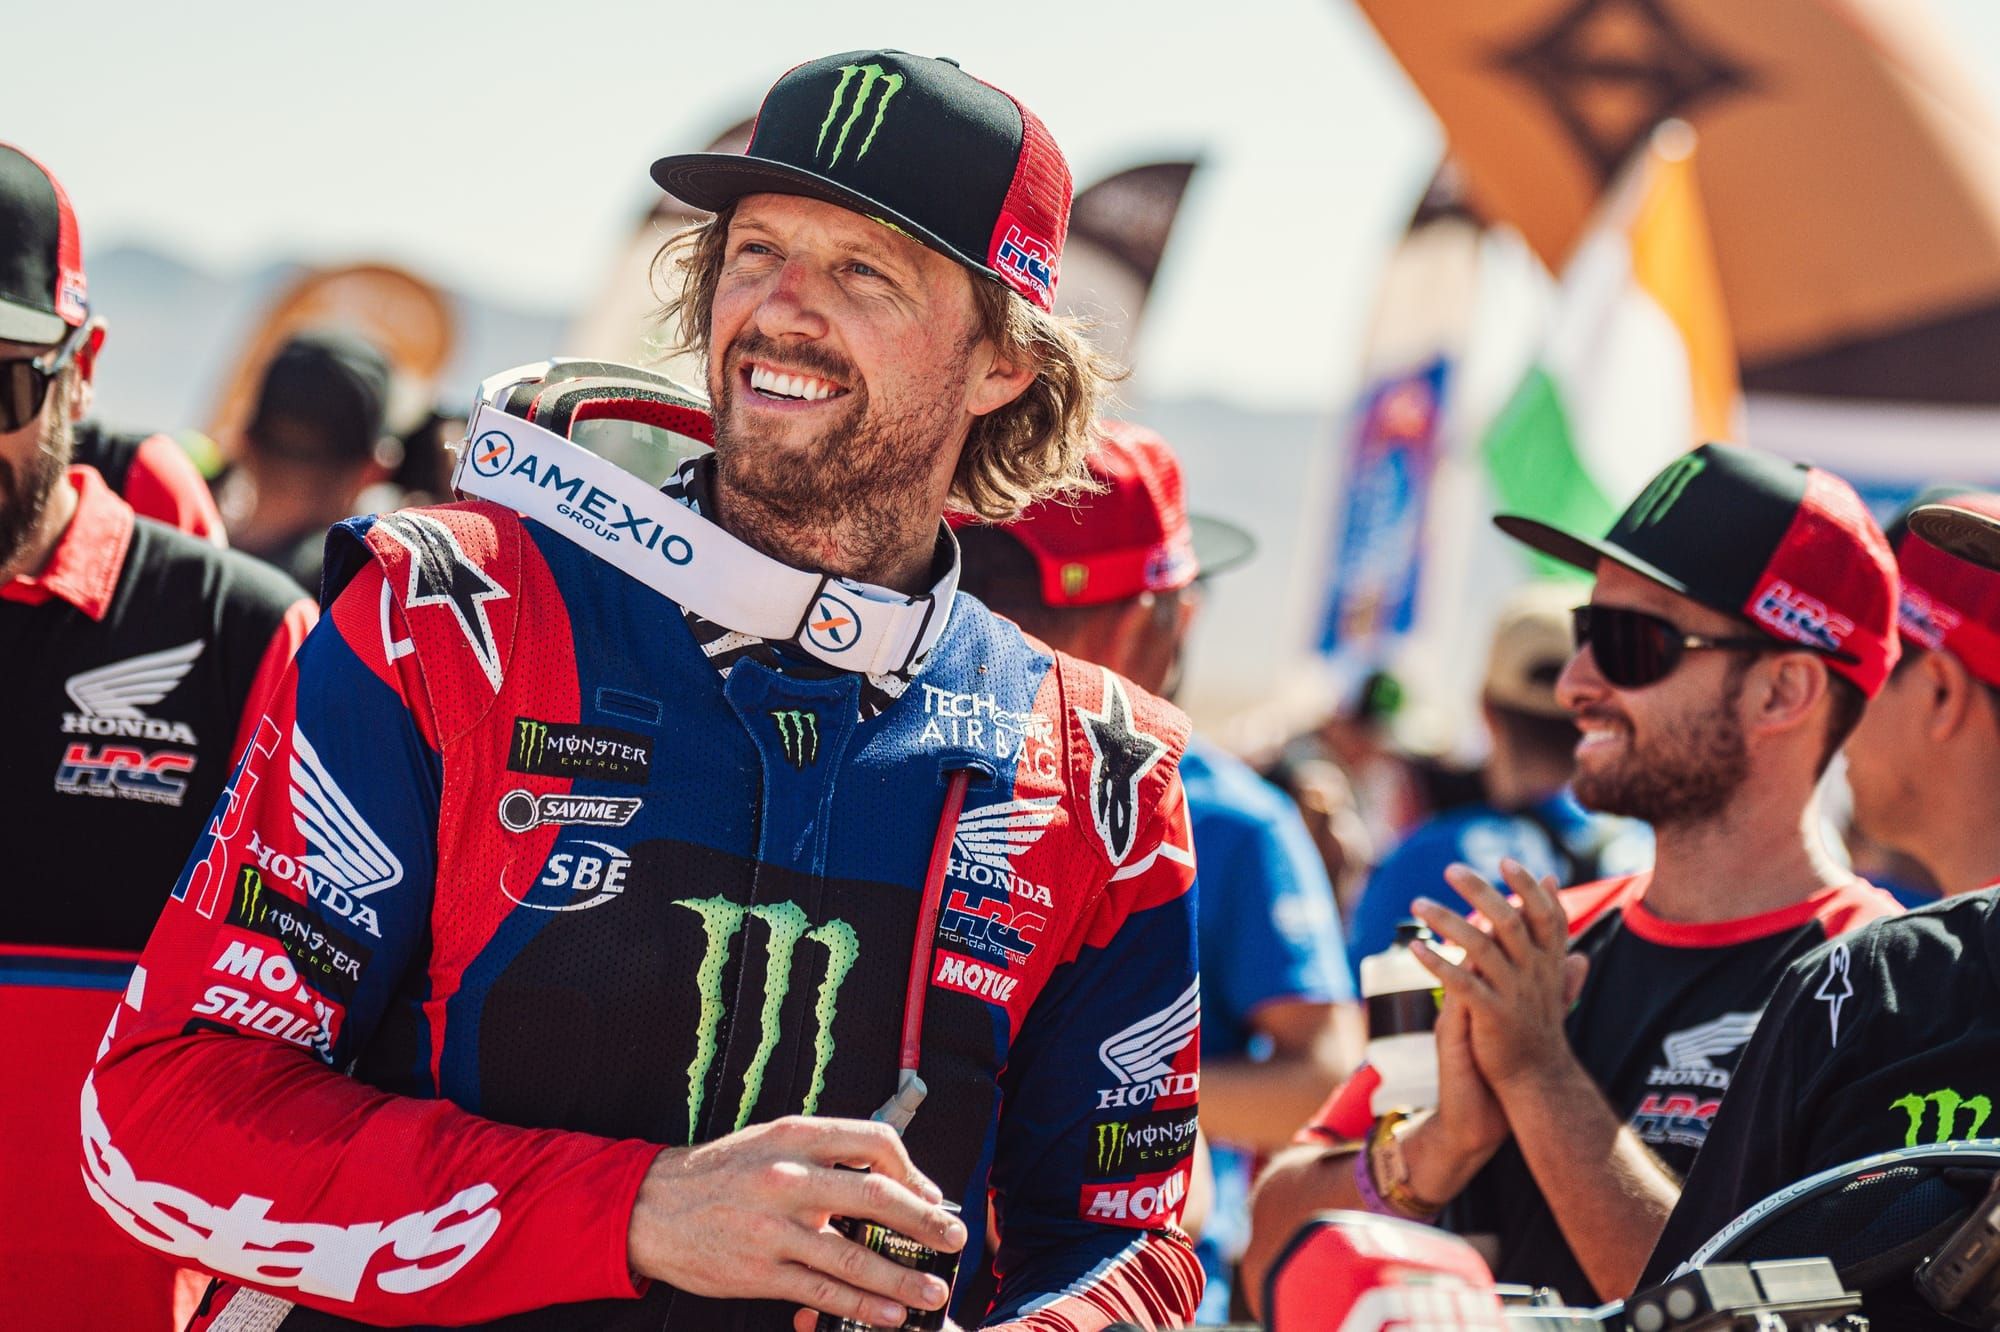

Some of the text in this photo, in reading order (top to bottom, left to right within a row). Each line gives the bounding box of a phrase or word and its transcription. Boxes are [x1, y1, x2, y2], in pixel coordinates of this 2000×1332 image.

[510, 455, 694, 566] AMEXIO
[556, 502, 621, 544] GROUP
[61, 711, 198, 746] HONDA
[55, 742, 198, 798] HRC
[546, 734, 649, 766] MONSTER
[561, 756, 630, 773] ENERGY
[543, 800, 618, 820] SAVIME
[245, 830, 383, 938] HONDA
[541, 853, 633, 894] SBE
[946, 857, 1054, 909] HONDA
[939, 888, 1047, 957] HRC
[938, 930, 1028, 967] Honda RACING
[936, 956, 1019, 1003] MOTUL
[1095, 1072, 1200, 1110] HOND
[1646, 1066, 1731, 1090] HOND
